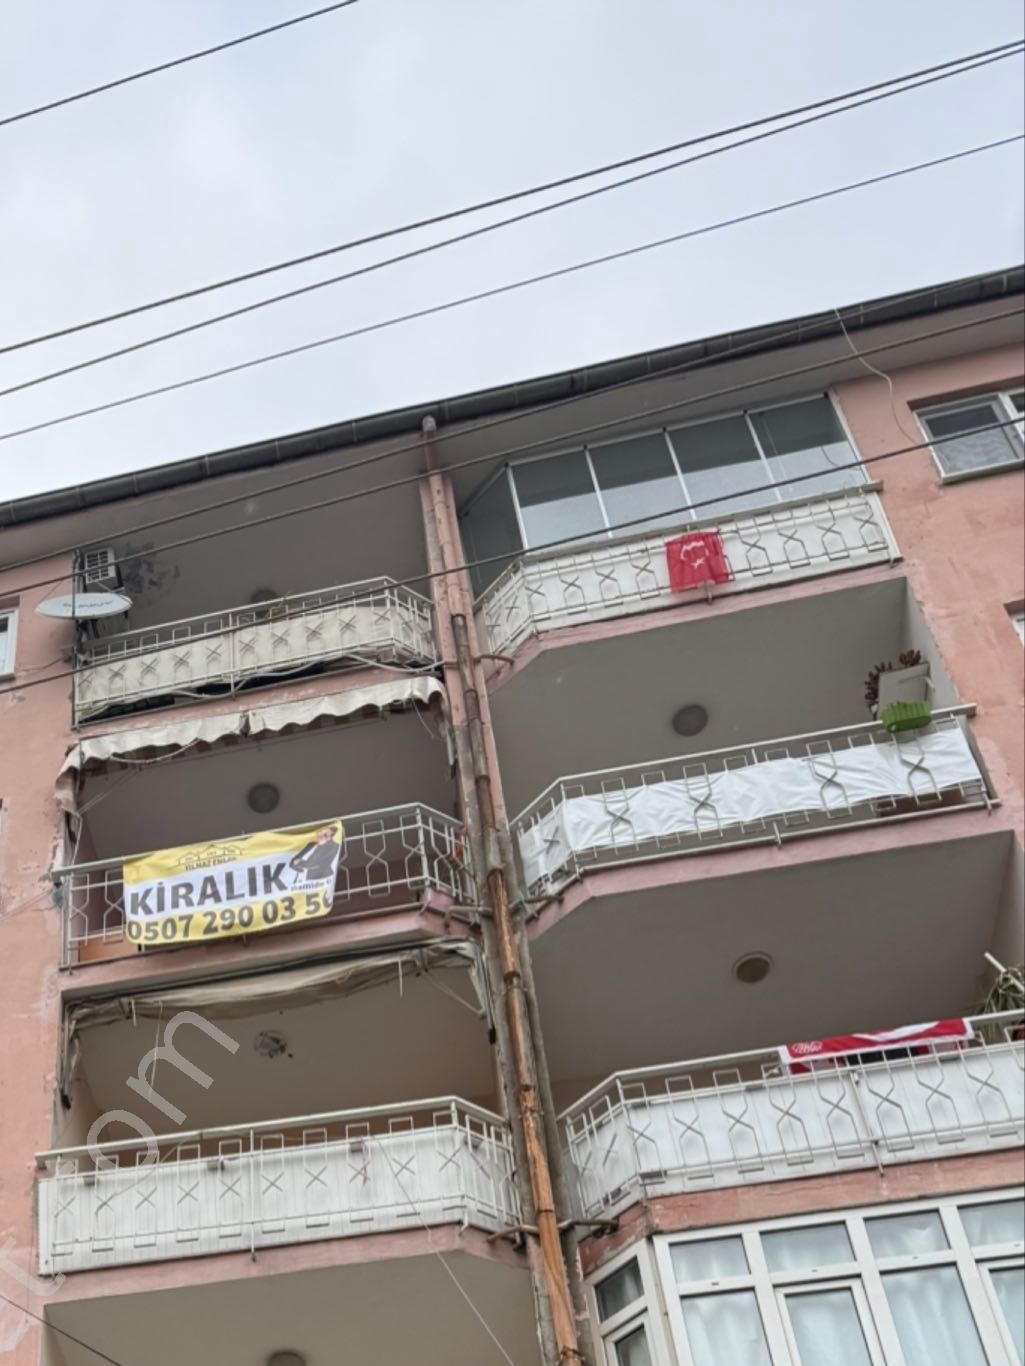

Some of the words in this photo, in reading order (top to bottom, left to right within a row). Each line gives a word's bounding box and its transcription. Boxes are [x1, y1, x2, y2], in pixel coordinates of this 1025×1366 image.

[129, 862, 288, 915] KİRALIK
[127, 915, 194, 941] 0507
[202, 905, 254, 933] 290
[262, 897, 296, 924] 03
